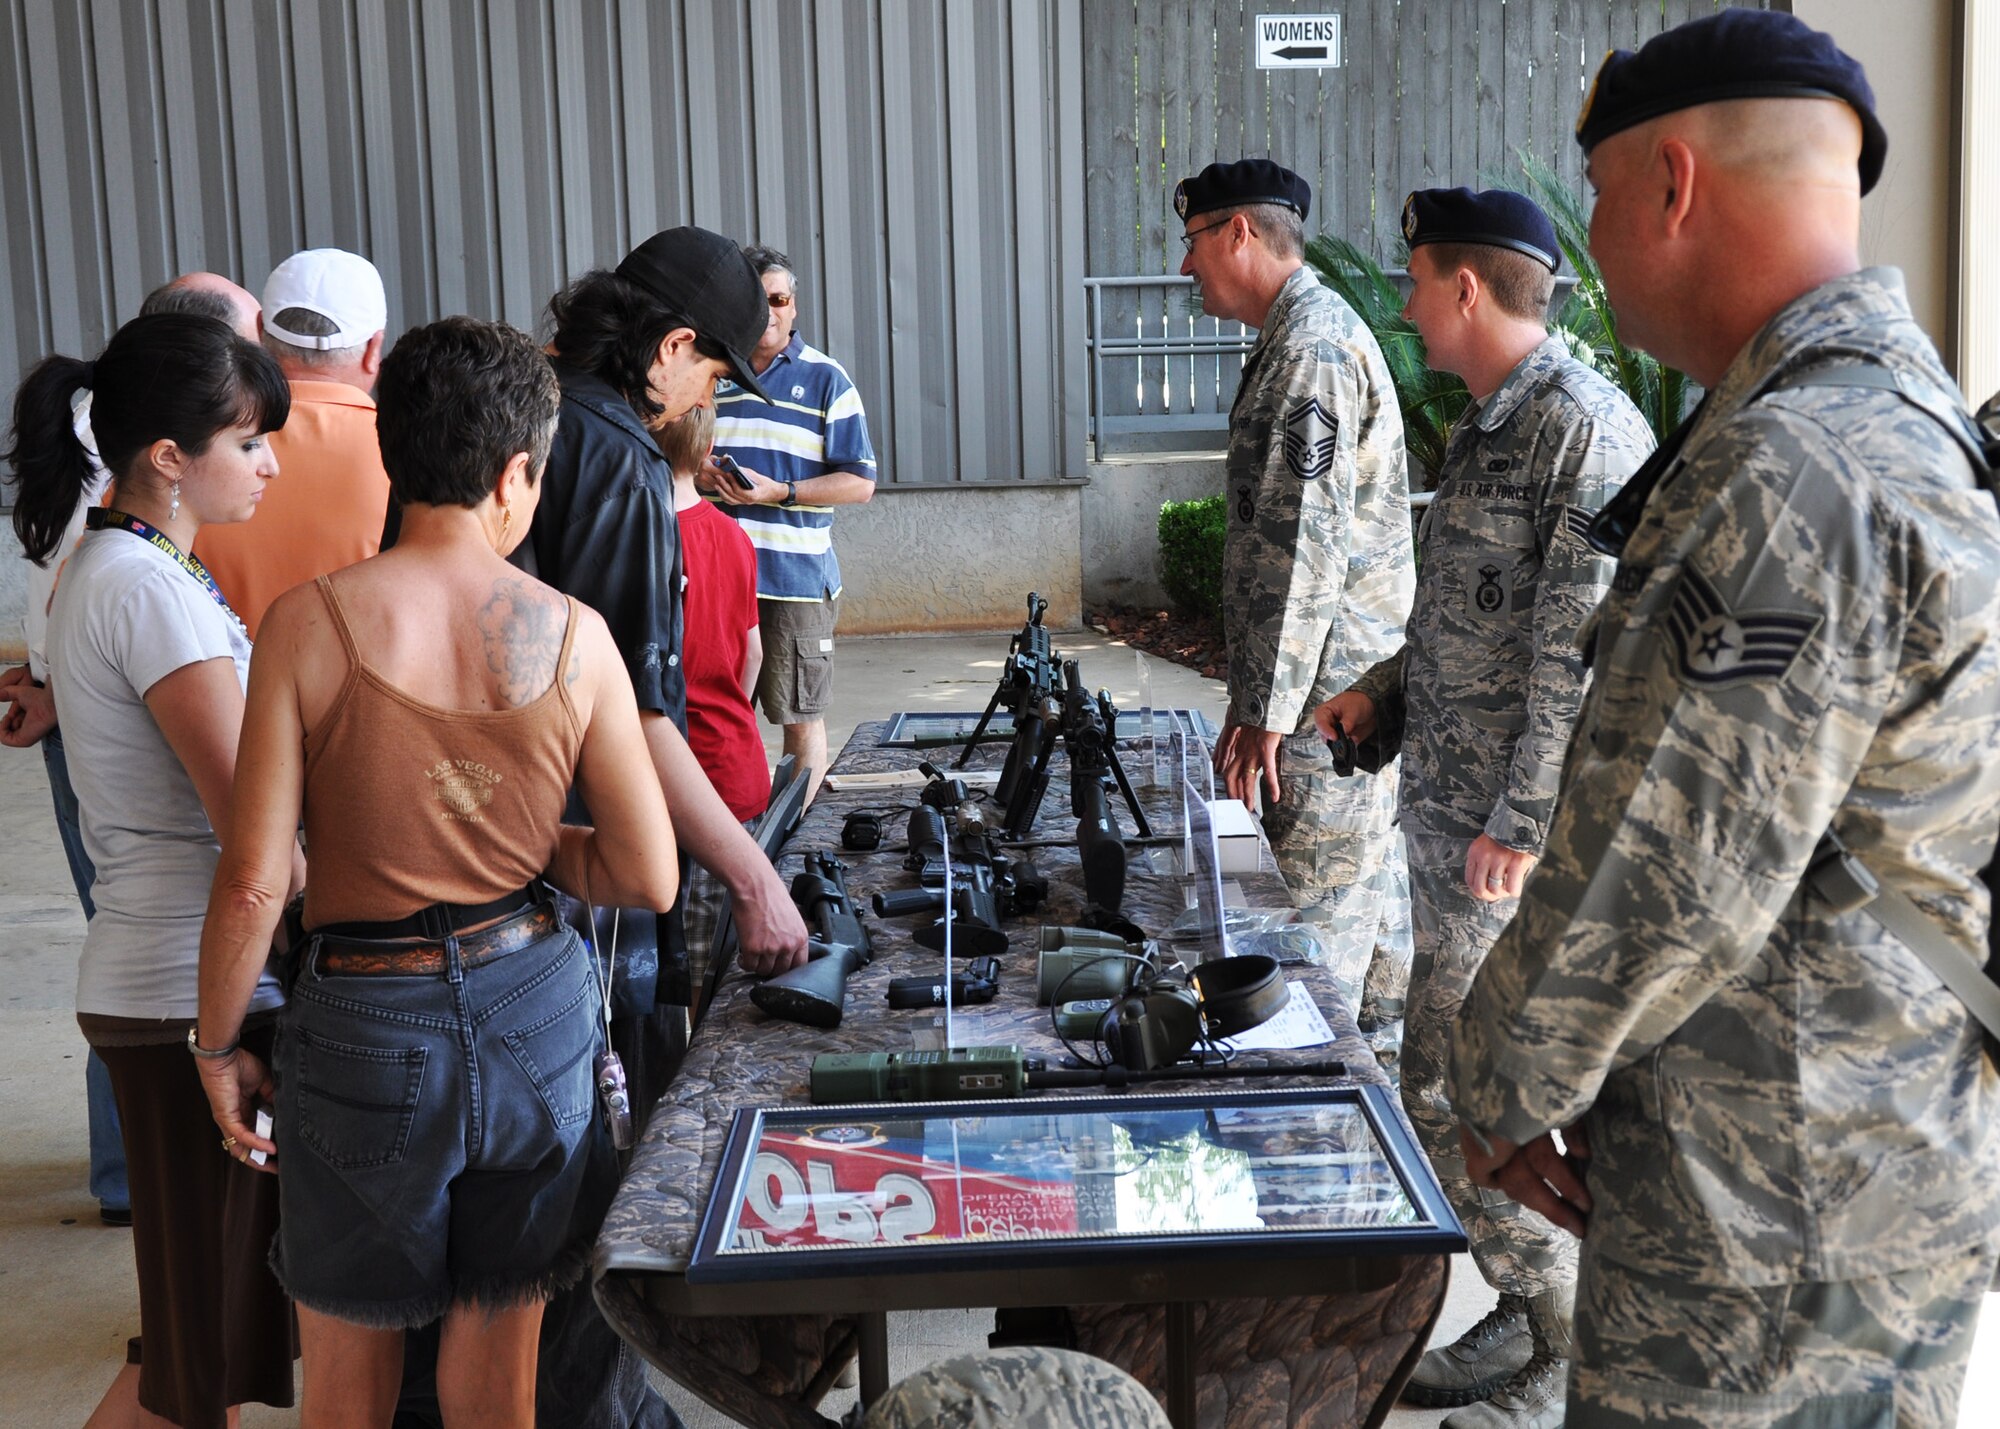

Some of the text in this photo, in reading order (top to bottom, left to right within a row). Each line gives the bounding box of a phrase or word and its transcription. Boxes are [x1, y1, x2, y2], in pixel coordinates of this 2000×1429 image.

[1264, 21, 1333, 41] WOMENS
[1476, 483, 1492, 498] AIR
[1496, 486, 1531, 501] FORCE
[424, 759, 503, 784] LAS VEGAS
[441, 812, 485, 823] NEVADA
[961, 1189, 1072, 1202] OPERATION
[986, 1200, 1034, 1208] TASK
